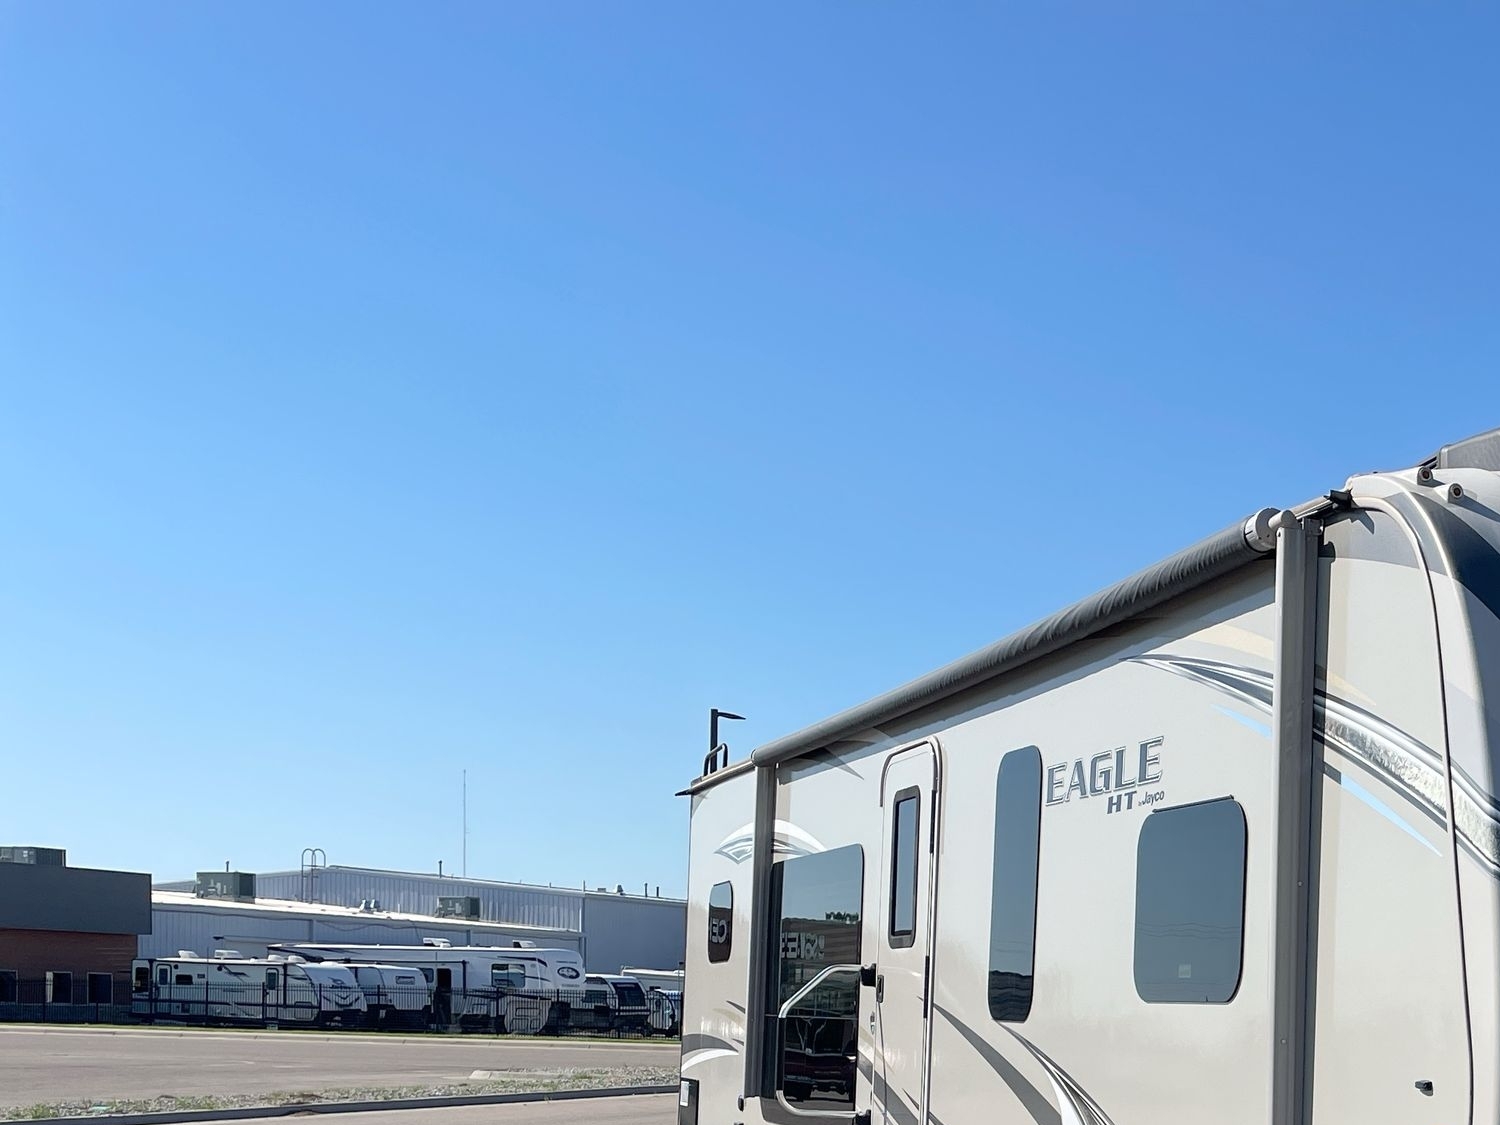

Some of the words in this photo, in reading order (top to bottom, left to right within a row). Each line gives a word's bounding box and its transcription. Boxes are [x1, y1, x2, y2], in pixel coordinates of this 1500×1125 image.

[1045, 735, 1164, 807] EAGLE
[1107, 791, 1137, 814] HT
[1142, 790, 1165, 806] Jayco
